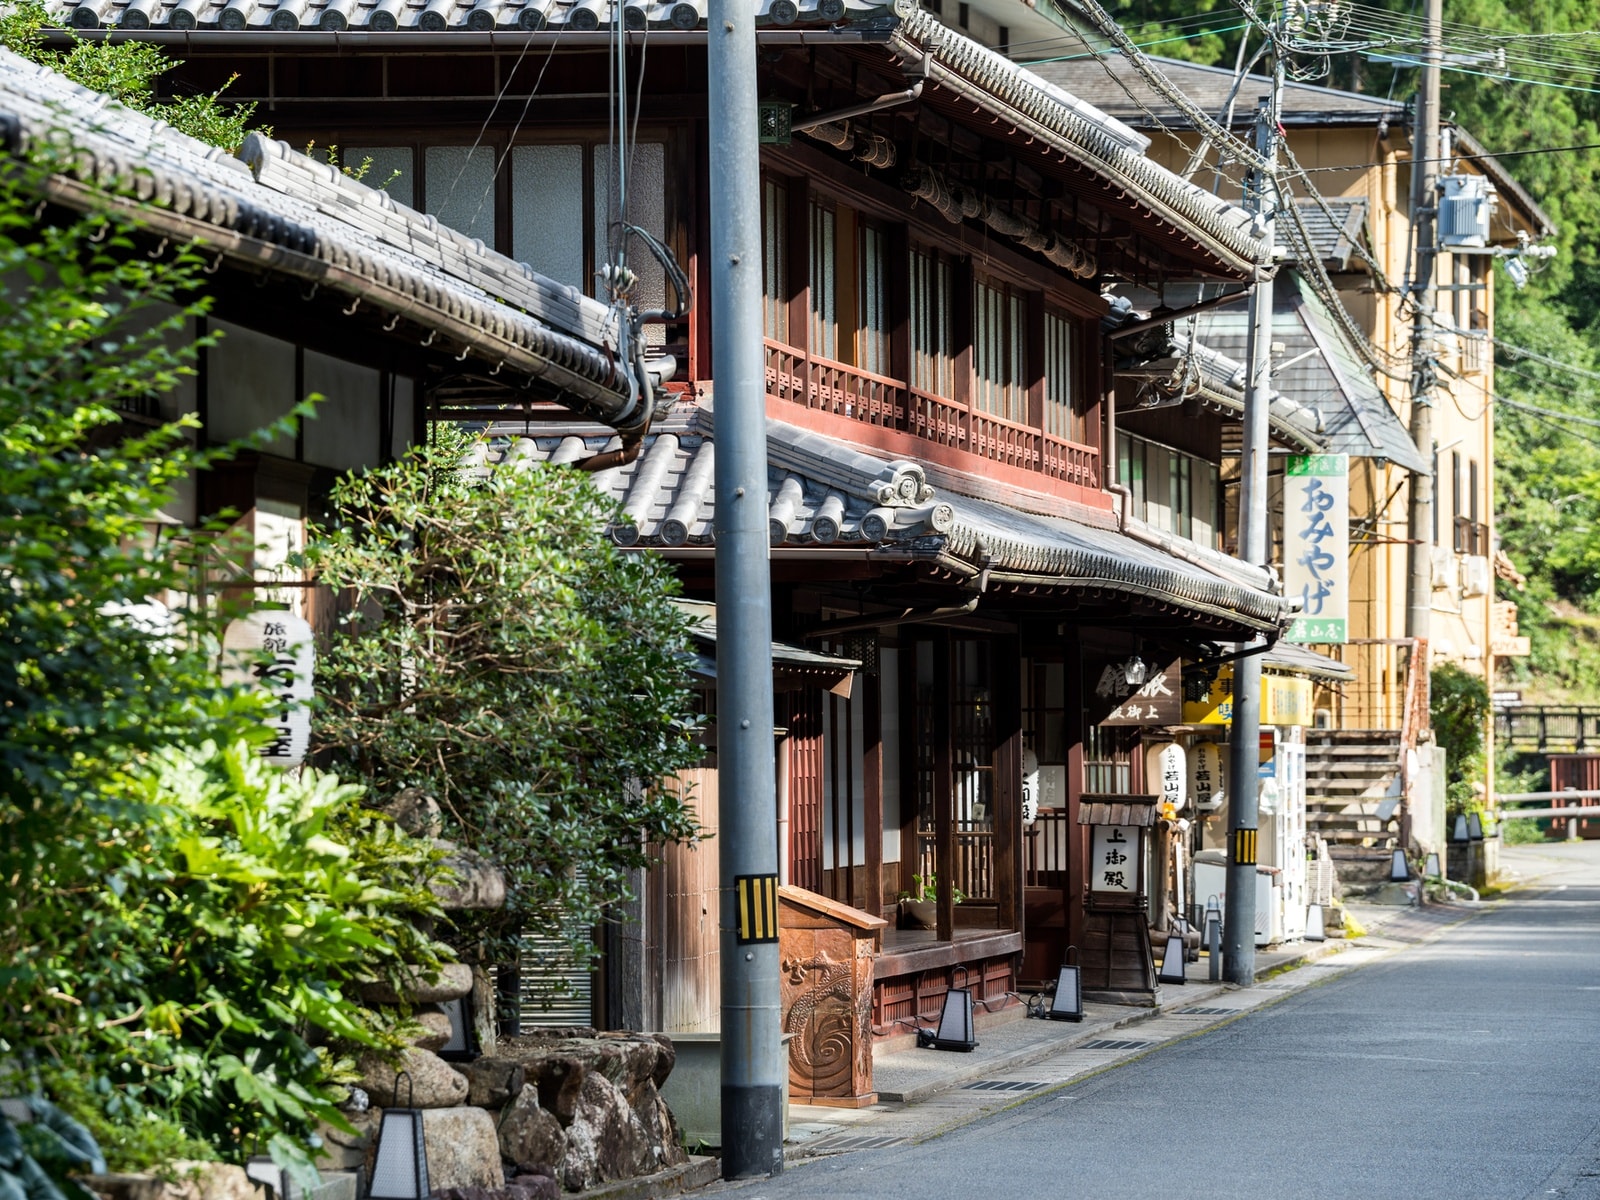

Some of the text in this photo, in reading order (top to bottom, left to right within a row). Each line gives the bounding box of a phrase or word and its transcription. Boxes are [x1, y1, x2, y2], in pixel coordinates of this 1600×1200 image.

[1296, 477, 1335, 616] おみやげ
[263, 621, 287, 653] 旅館
[1104, 828, 1129, 890] 上御殿
